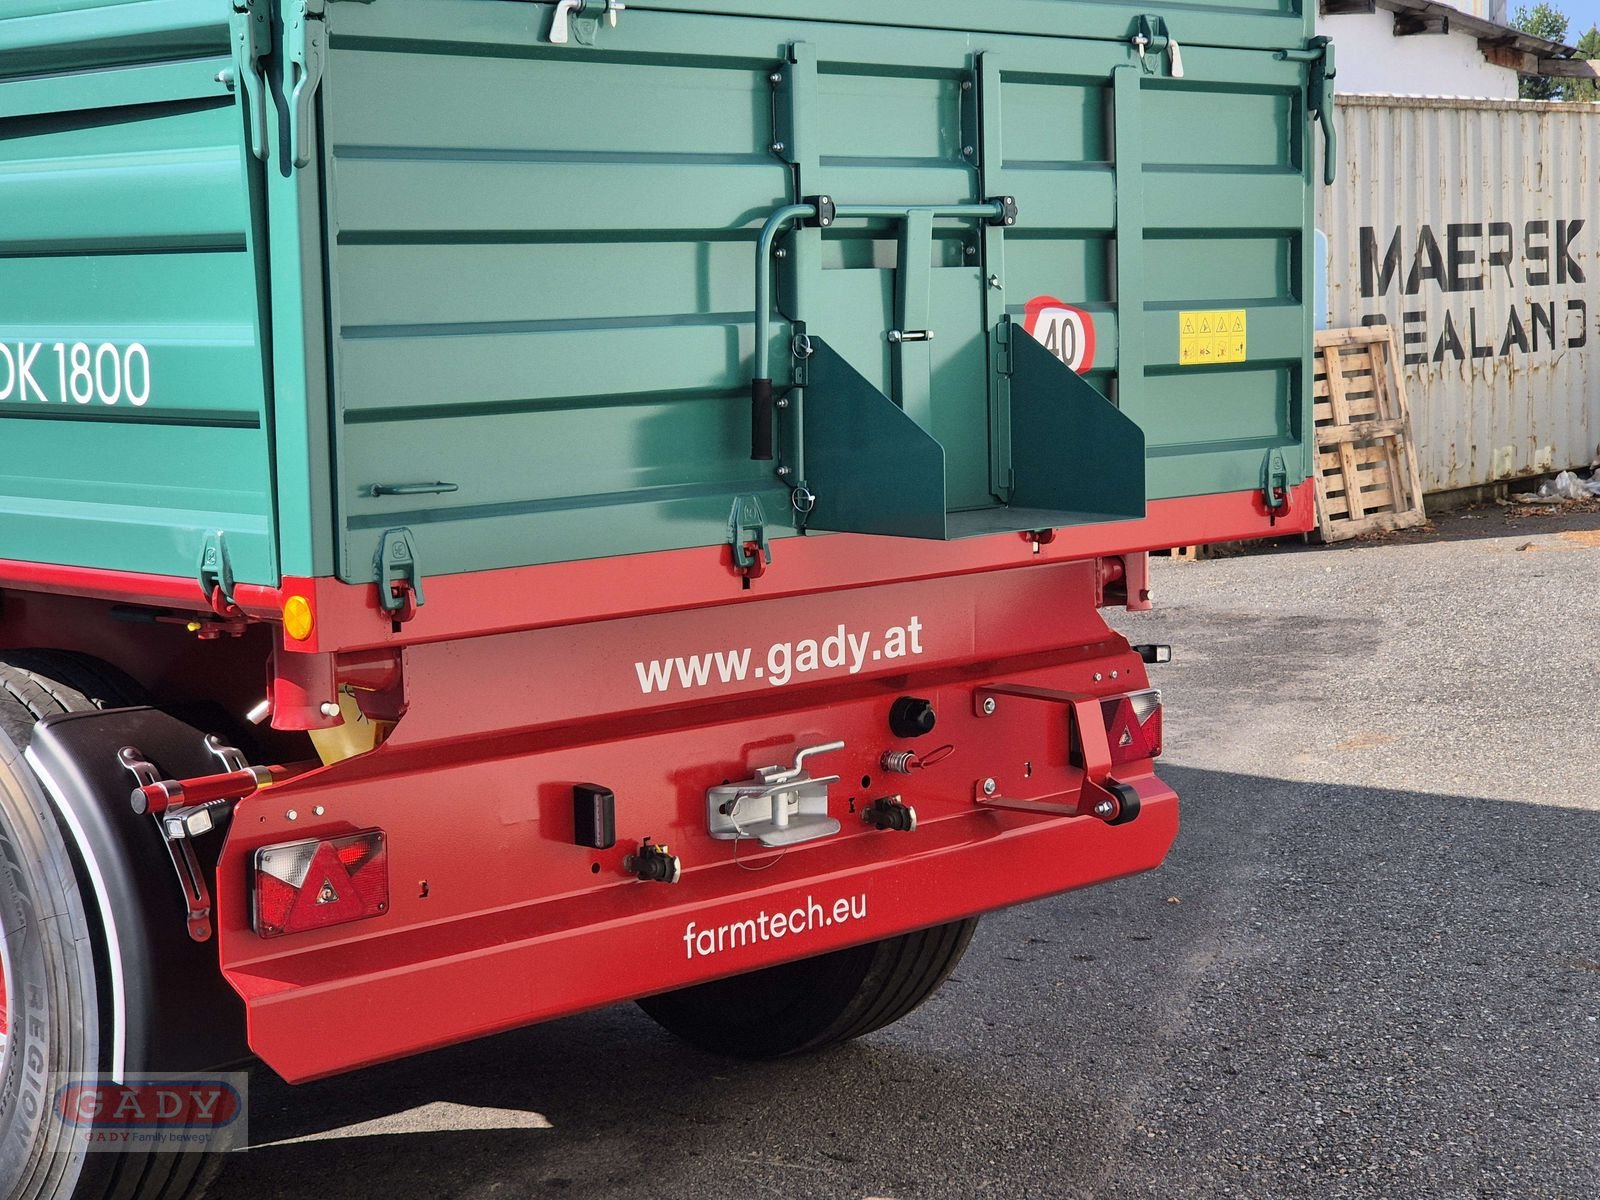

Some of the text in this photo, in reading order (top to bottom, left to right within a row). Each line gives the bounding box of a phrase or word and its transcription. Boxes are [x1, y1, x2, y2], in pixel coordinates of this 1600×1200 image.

[1359, 219, 1586, 298] MAERSK
[53, 342, 150, 406] 1800
[1044, 317, 1077, 367] 40
[634, 615, 924, 694] www.gady.at
[683, 893, 867, 959] farmtech.eu
